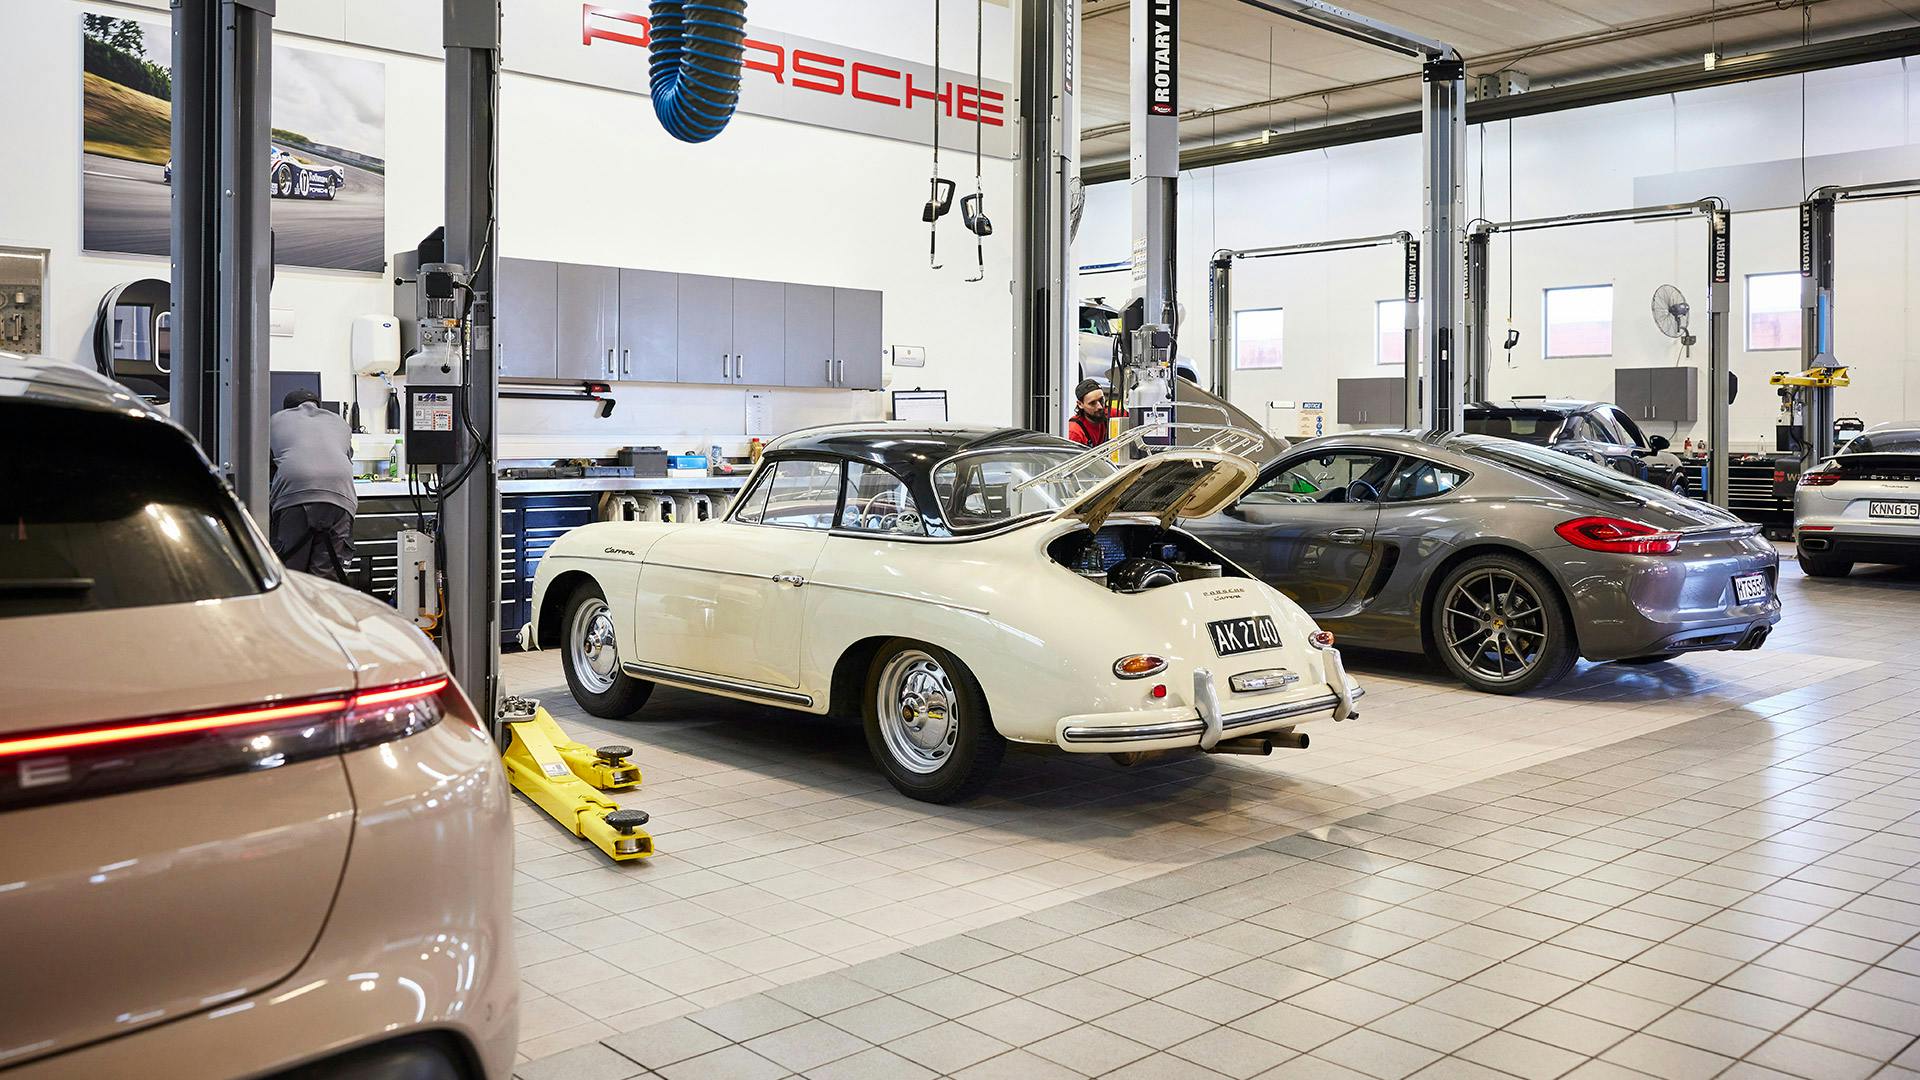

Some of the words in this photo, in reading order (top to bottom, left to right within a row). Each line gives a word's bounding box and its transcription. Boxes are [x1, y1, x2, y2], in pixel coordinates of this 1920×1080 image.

[583, 3, 1004, 127] PRSCHE
[1154, 21, 1170, 102] ROTARY
[1409, 243, 1417, 261] LIFT
[1716, 237, 1725, 277] ROTARY
[1802, 230, 1810, 271] ROTARY
[1408, 262, 1416, 297] ROTARY
[1871, 502, 1918, 515] KNN615
[604, 546, 636, 555] Carrera
[1215, 622, 1244, 652] AK
[1239, 619, 1279, 648] 2740
